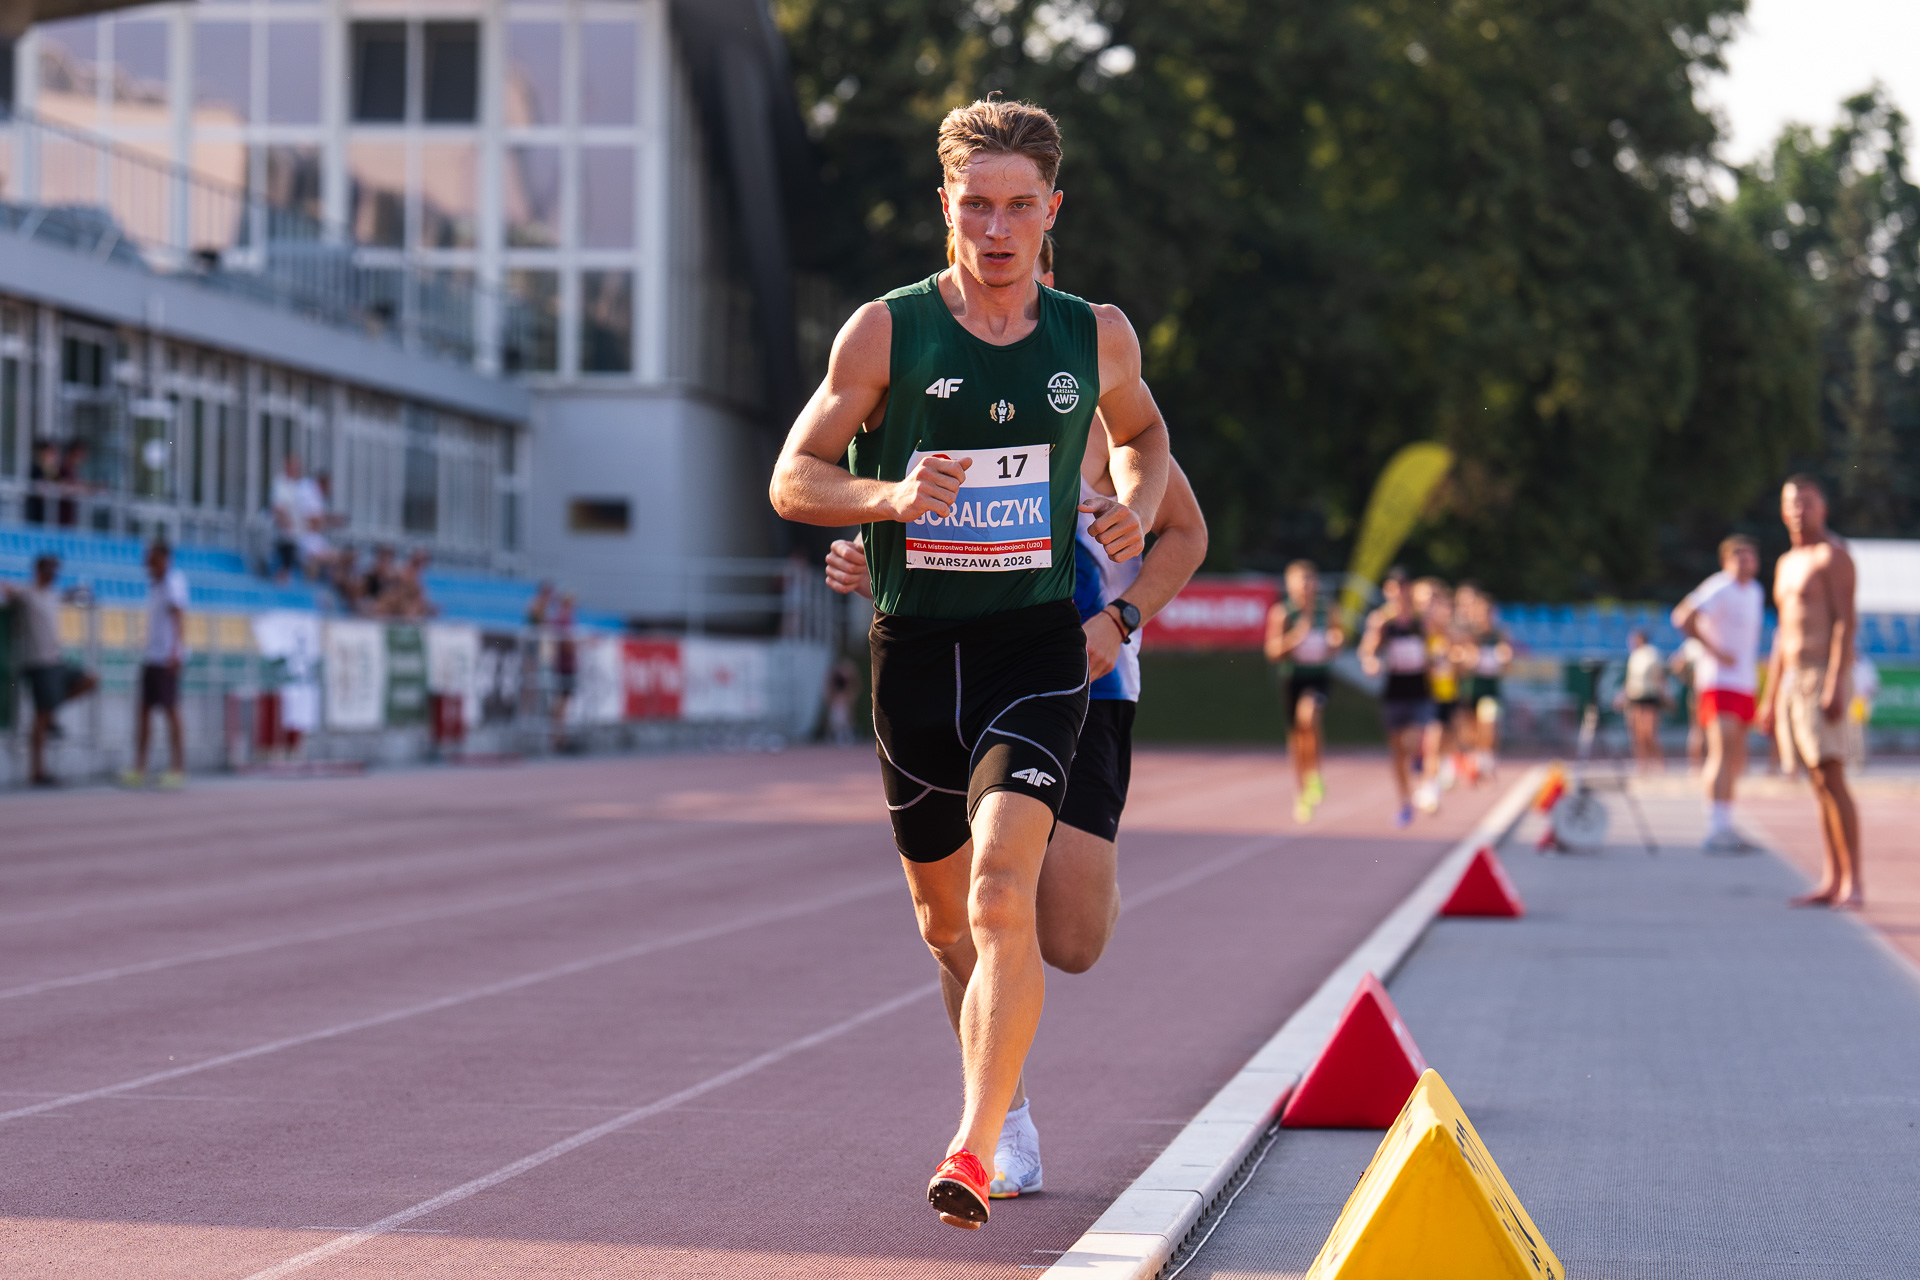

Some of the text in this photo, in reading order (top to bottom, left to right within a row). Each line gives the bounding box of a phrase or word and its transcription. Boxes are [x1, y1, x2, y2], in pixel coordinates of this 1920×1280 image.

[925, 377, 963, 398] 4F
[1055, 378, 1073, 388] AZS
[1054, 394, 1076, 404] AWF
[997, 454, 1028, 479] 17
[990, 544, 1025, 552] wielobojach
[923, 555, 1032, 568] WARSZAWA 2026
[1011, 767, 1057, 788] 4F
